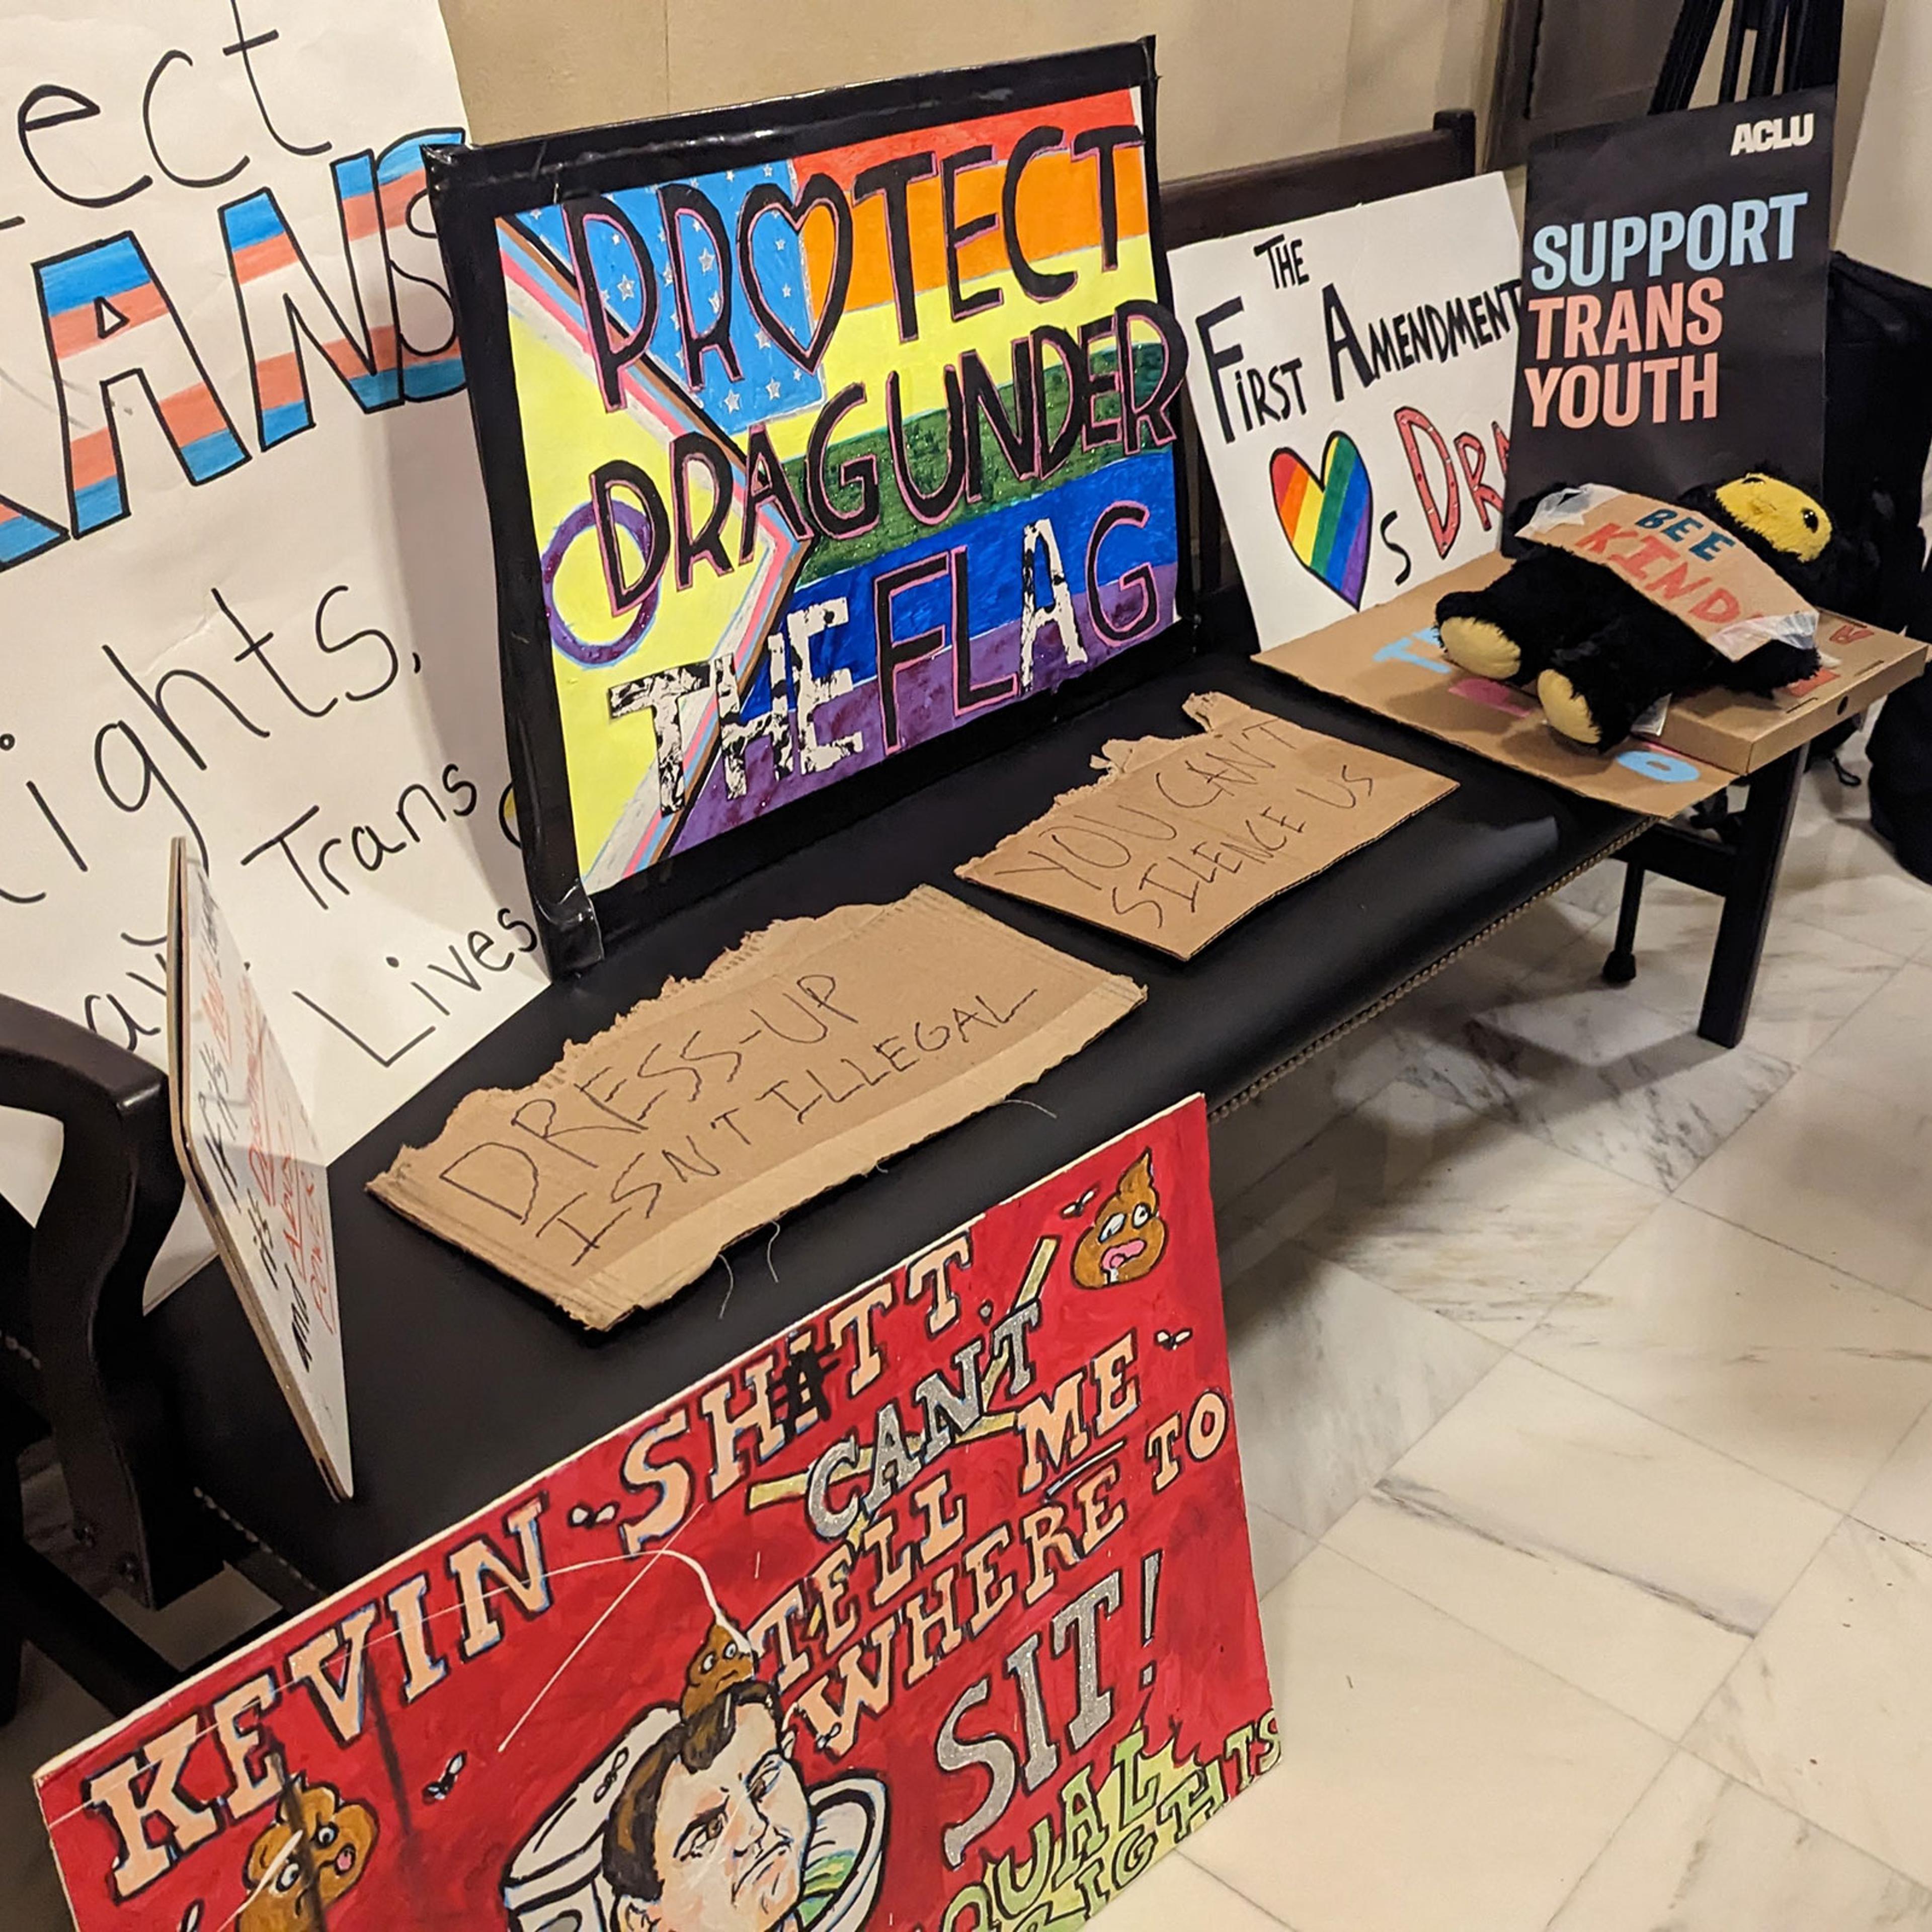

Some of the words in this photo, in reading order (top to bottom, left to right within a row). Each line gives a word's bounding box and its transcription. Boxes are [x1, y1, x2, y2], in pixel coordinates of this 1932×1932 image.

[1730, 114, 1814, 156] ACLU
[1253, 234, 1310, 289] THE
[1531, 192, 1808, 291] SUPPORT
[0, 127, 467, 572] ANS
[1321, 279, 1521, 402] AMENDMENT
[1528, 277, 1724, 360] TRANS
[1524, 353, 1718, 429] YOUTH
[1575, 522, 1741, 624] KIND
[1635, 508, 1736, 562] BEE
[609, 598, 863, 816] THE
[875, 501, 1156, 756] FLAG
[240, 763, 477, 910] Trans
[994, 805, 1178, 891] YOU
[1112, 807, 1306, 928] SILENCE
[1297, 764, 1373, 809] US
[293, 907, 538, 1067] Lives
[755, 989, 1037, 1125] ILLEGAL
[439, 974, 858, 1225] DRESS-UP
[747, 1474, 965, 1695] TELL
[1015, 1327, 1143, 1494] ME
[794, 1465, 1126, 1757] WHERE
[1146, 1388, 1231, 1493] TO
[83, 1490, 552, 1906] KEVIN
[934, 1550, 1164, 1872] SIT!
